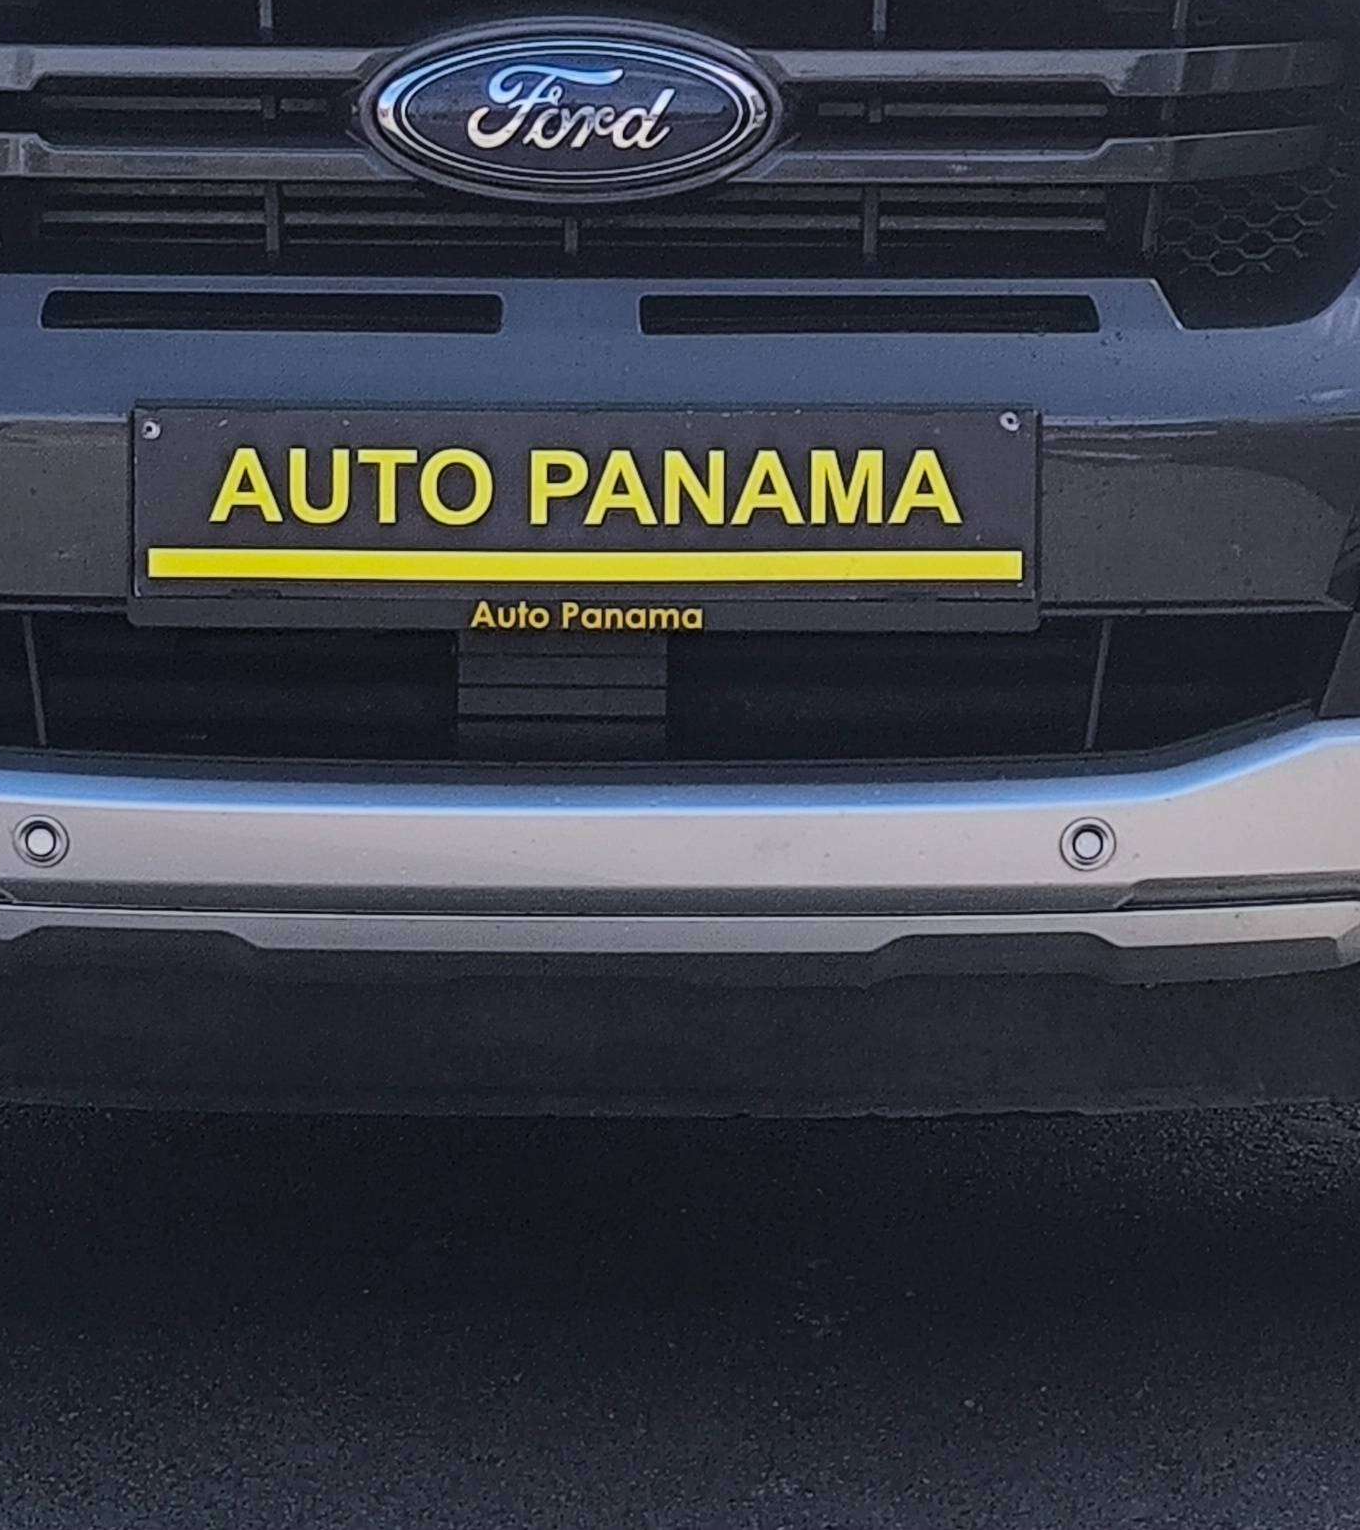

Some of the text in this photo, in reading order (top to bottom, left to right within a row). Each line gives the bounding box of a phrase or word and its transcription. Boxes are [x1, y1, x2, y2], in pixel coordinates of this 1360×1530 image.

[467, 64, 676, 149] Ford
[210, 448, 962, 526] AUTO PANAMA
[470, 601, 703, 630] Auto Panama
